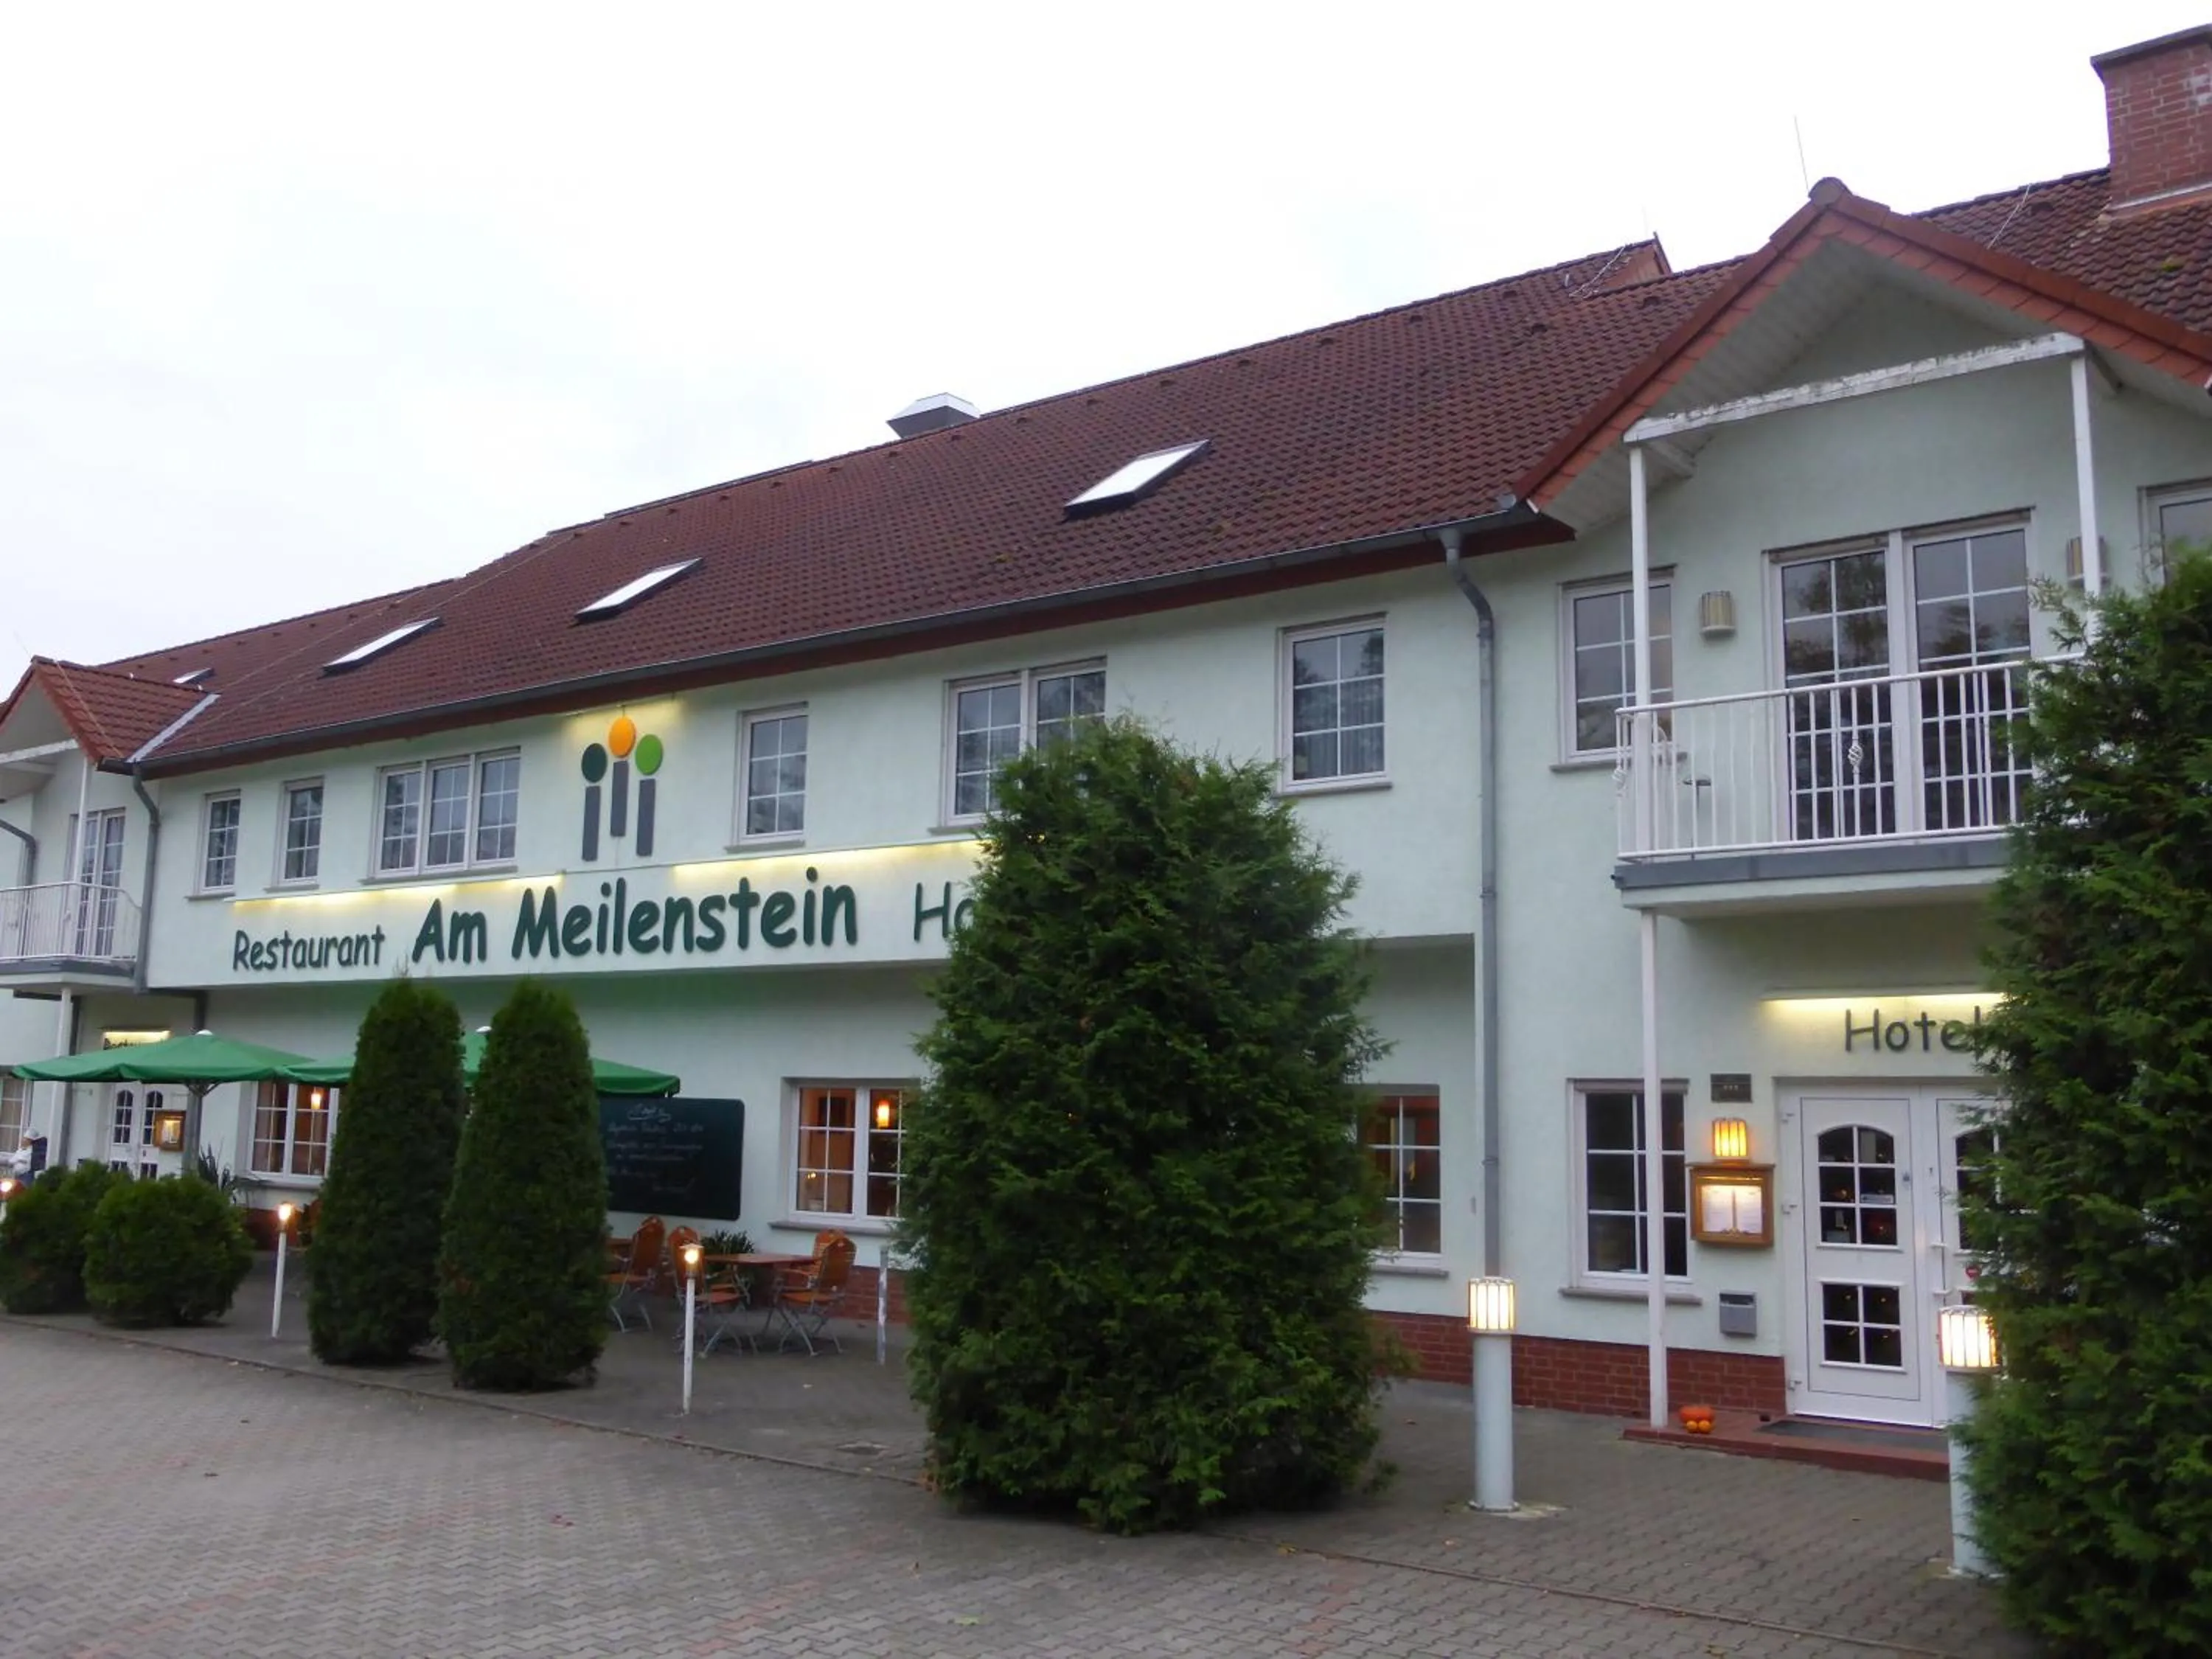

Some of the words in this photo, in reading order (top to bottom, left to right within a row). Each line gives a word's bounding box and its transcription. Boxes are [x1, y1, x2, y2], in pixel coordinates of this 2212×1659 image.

[233, 924, 385, 971] Restaurant
[411, 897, 488, 964] Am
[511, 866, 858, 959] Meilenstein
